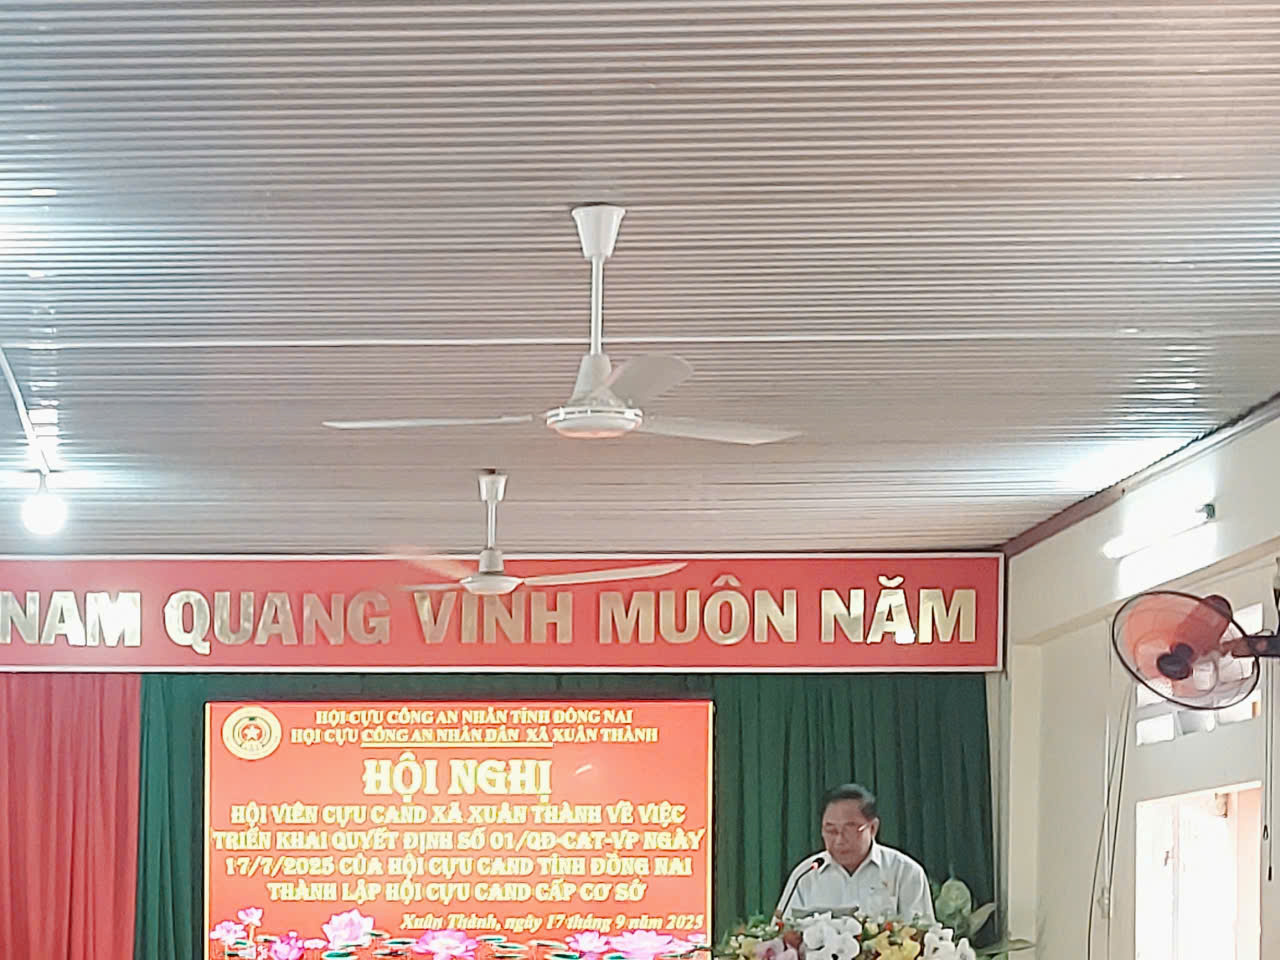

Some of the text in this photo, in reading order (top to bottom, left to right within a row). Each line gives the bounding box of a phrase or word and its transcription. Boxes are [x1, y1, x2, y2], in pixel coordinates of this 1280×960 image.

[163, 590, 391, 655] QUANG
[413, 589, 573, 645] VINH
[599, 575, 797, 646] MUÔN
[820, 575, 977, 645] NĂM
[386, 706, 434, 725] CÔNG
[436, 710, 460, 725] AN
[462, 706, 509, 725] NHÂN
[603, 709, 633, 724] NAI
[323, 727, 359, 746] CỰU
[361, 726, 409, 742] CÔNG
[410, 727, 434, 742] AN
[436, 725, 483, 742] NHÂN
[485, 724, 520, 742] DÂN
[551, 724, 599, 742] XUÂN
[600, 724, 658, 742] THÀNH
[362, 751, 553, 804] HỘI NGHỊ
[231, 801, 687, 827] HỘI VIÊN CỰU CAND XÃ XUÂN THÀNH VỀ VIỆC
[212, 826, 705, 853] TRIỂN KHAI QUYẾT ĐỊNH SỐ 01/QĐ-CAT-VP NGÀY
[225, 856, 335, 877] 17/7/2025
[338, 852, 384, 875] CỦA
[387, 852, 425, 877] HỘI
[428, 857, 474, 879] CỰU
[476, 857, 535, 876] CAND
[590, 851, 650, 876] ĐỒNG
[654, 857, 693, 875] NAI
[267, 878, 647, 904] THÀNH LẬP HỘI CỰU CAND CẤP CƠ SỞ
[400, 913, 444, 930] Xuân
[504, 914, 543, 933] ngày
[546, 914, 567, 930] 17
[566, 913, 611, 933] tháng
[615, 914, 626, 929] 9
[628, 914, 663, 929] năm
[665, 914, 705, 930] 2025
